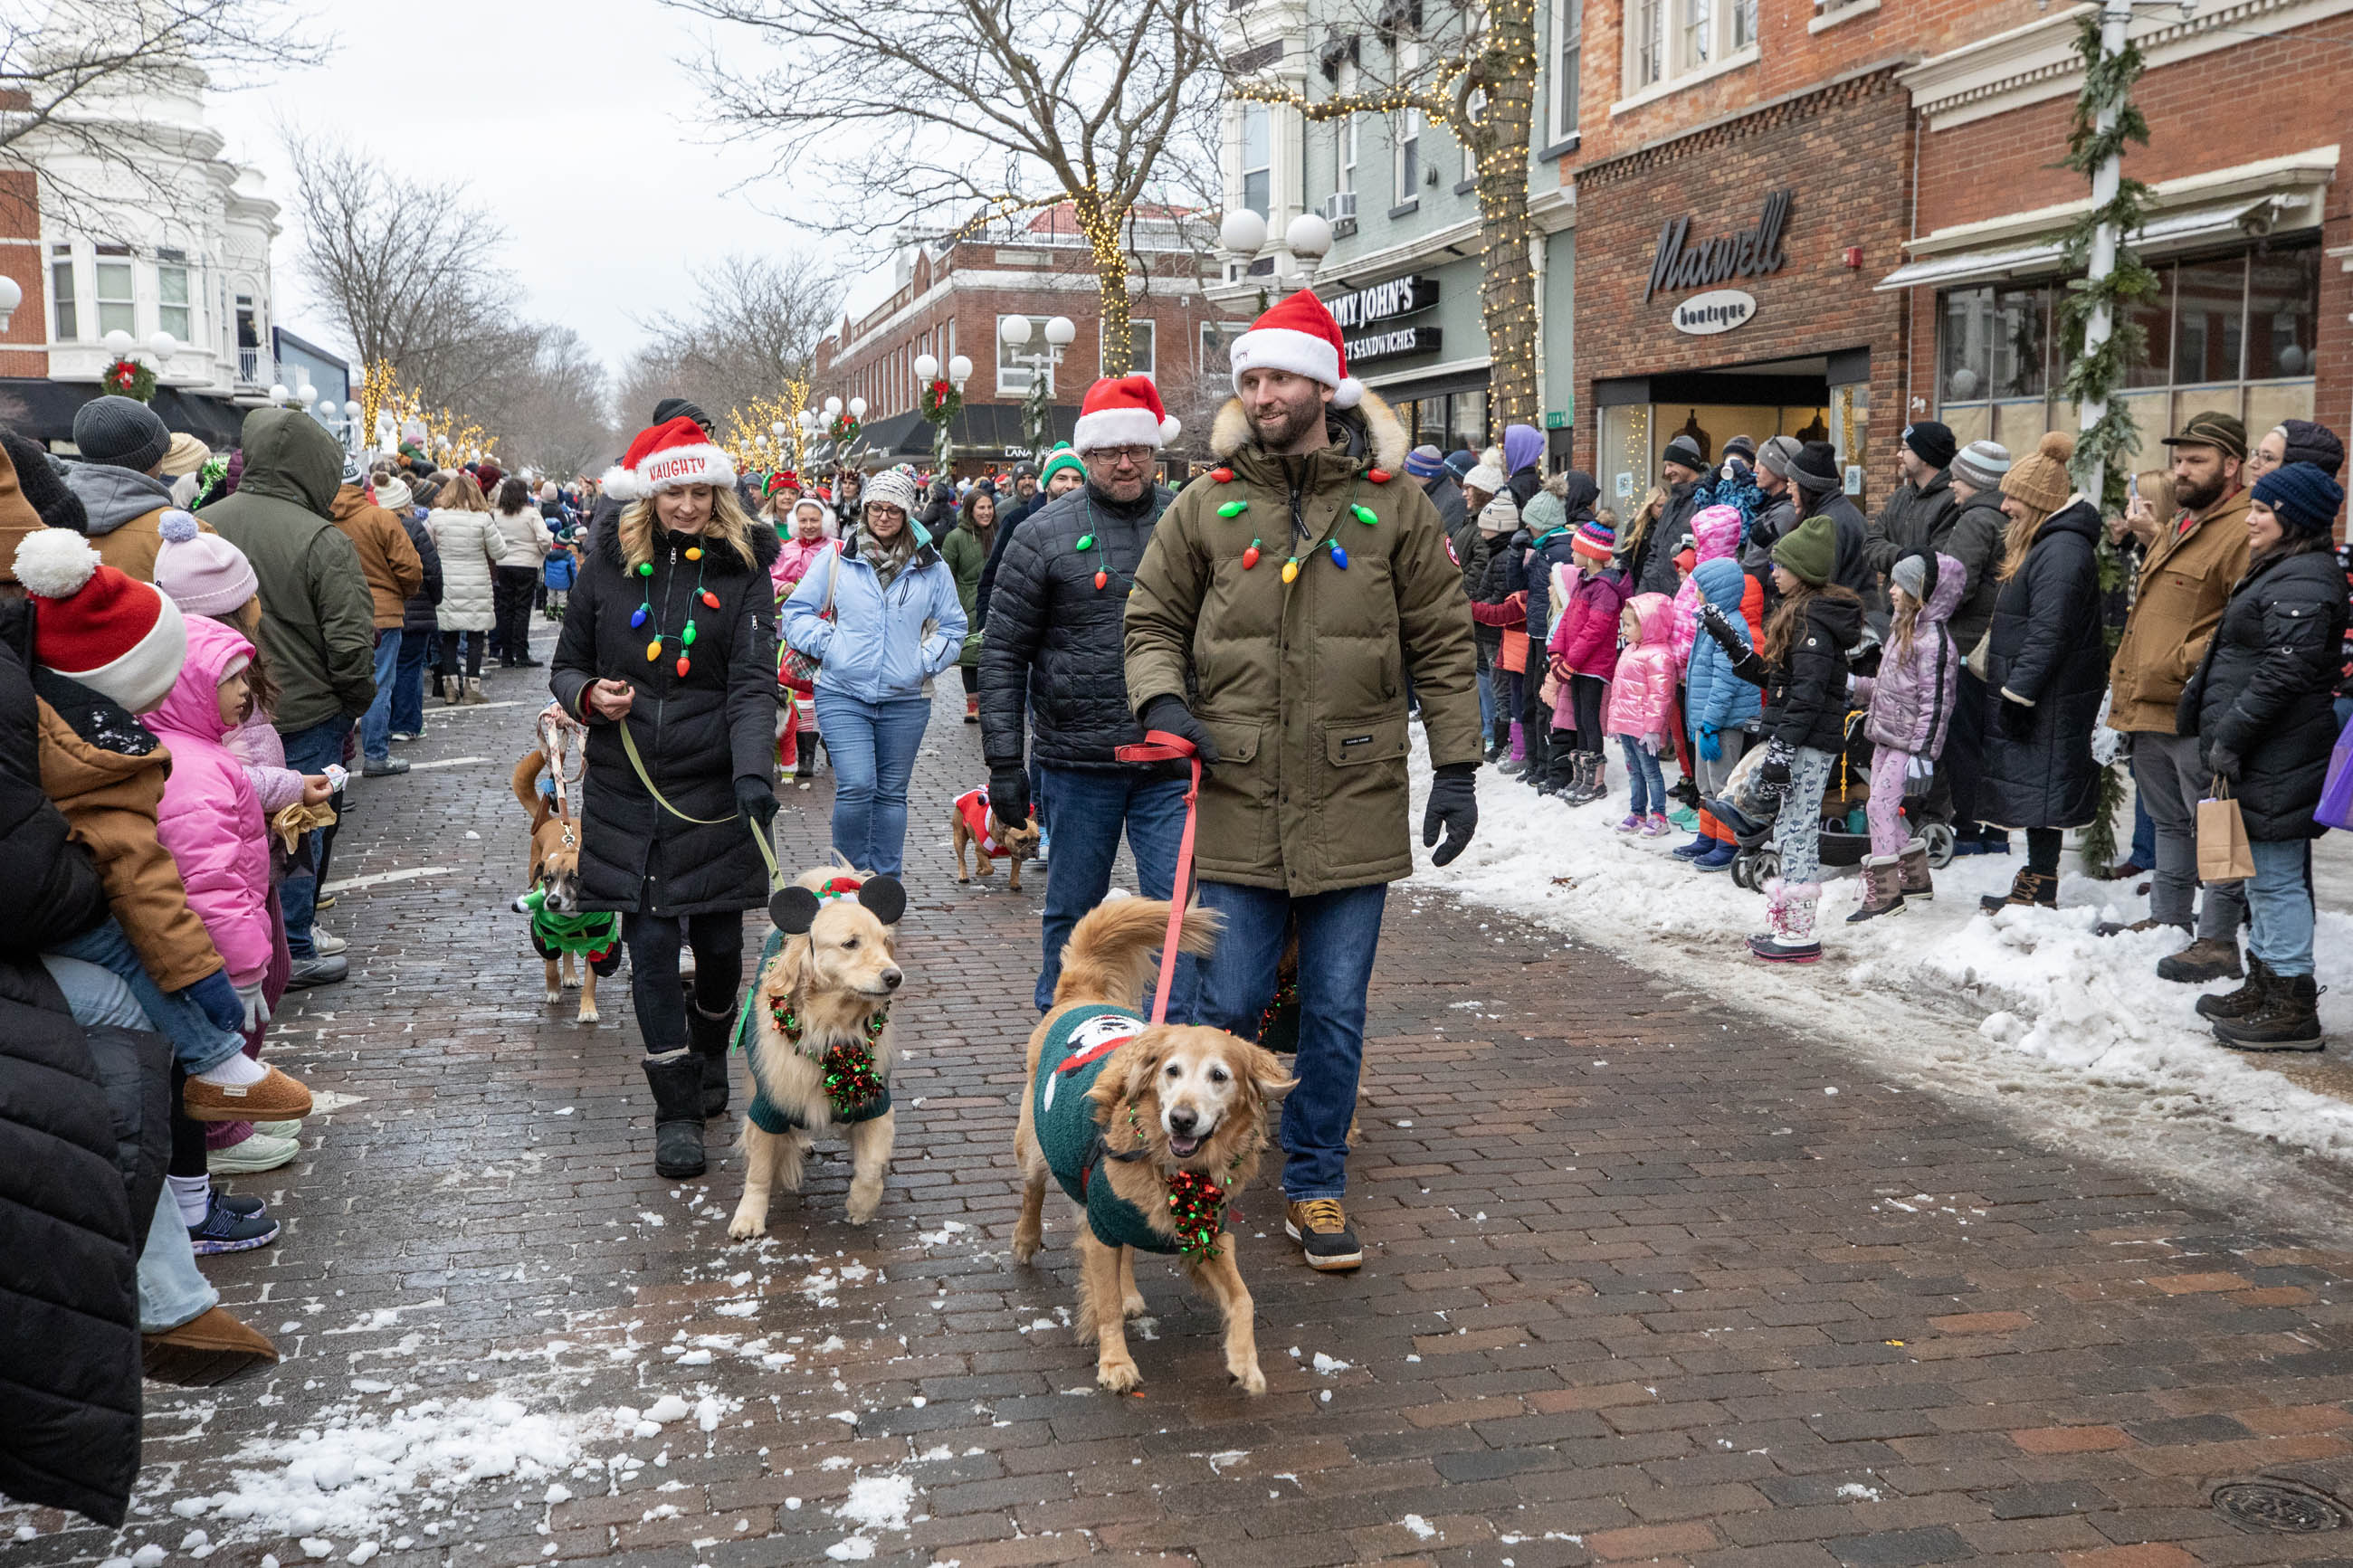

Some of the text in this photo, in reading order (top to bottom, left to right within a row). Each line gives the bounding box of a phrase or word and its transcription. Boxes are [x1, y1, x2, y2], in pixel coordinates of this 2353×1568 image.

[1643, 188, 1792, 304] Maxwell
[1358, 275, 1414, 328] JOHN'S
[1681, 303, 1746, 327] boutique
[1353, 328, 1416, 359] SANDWICHES
[649, 457, 705, 482] NAUGHTY
